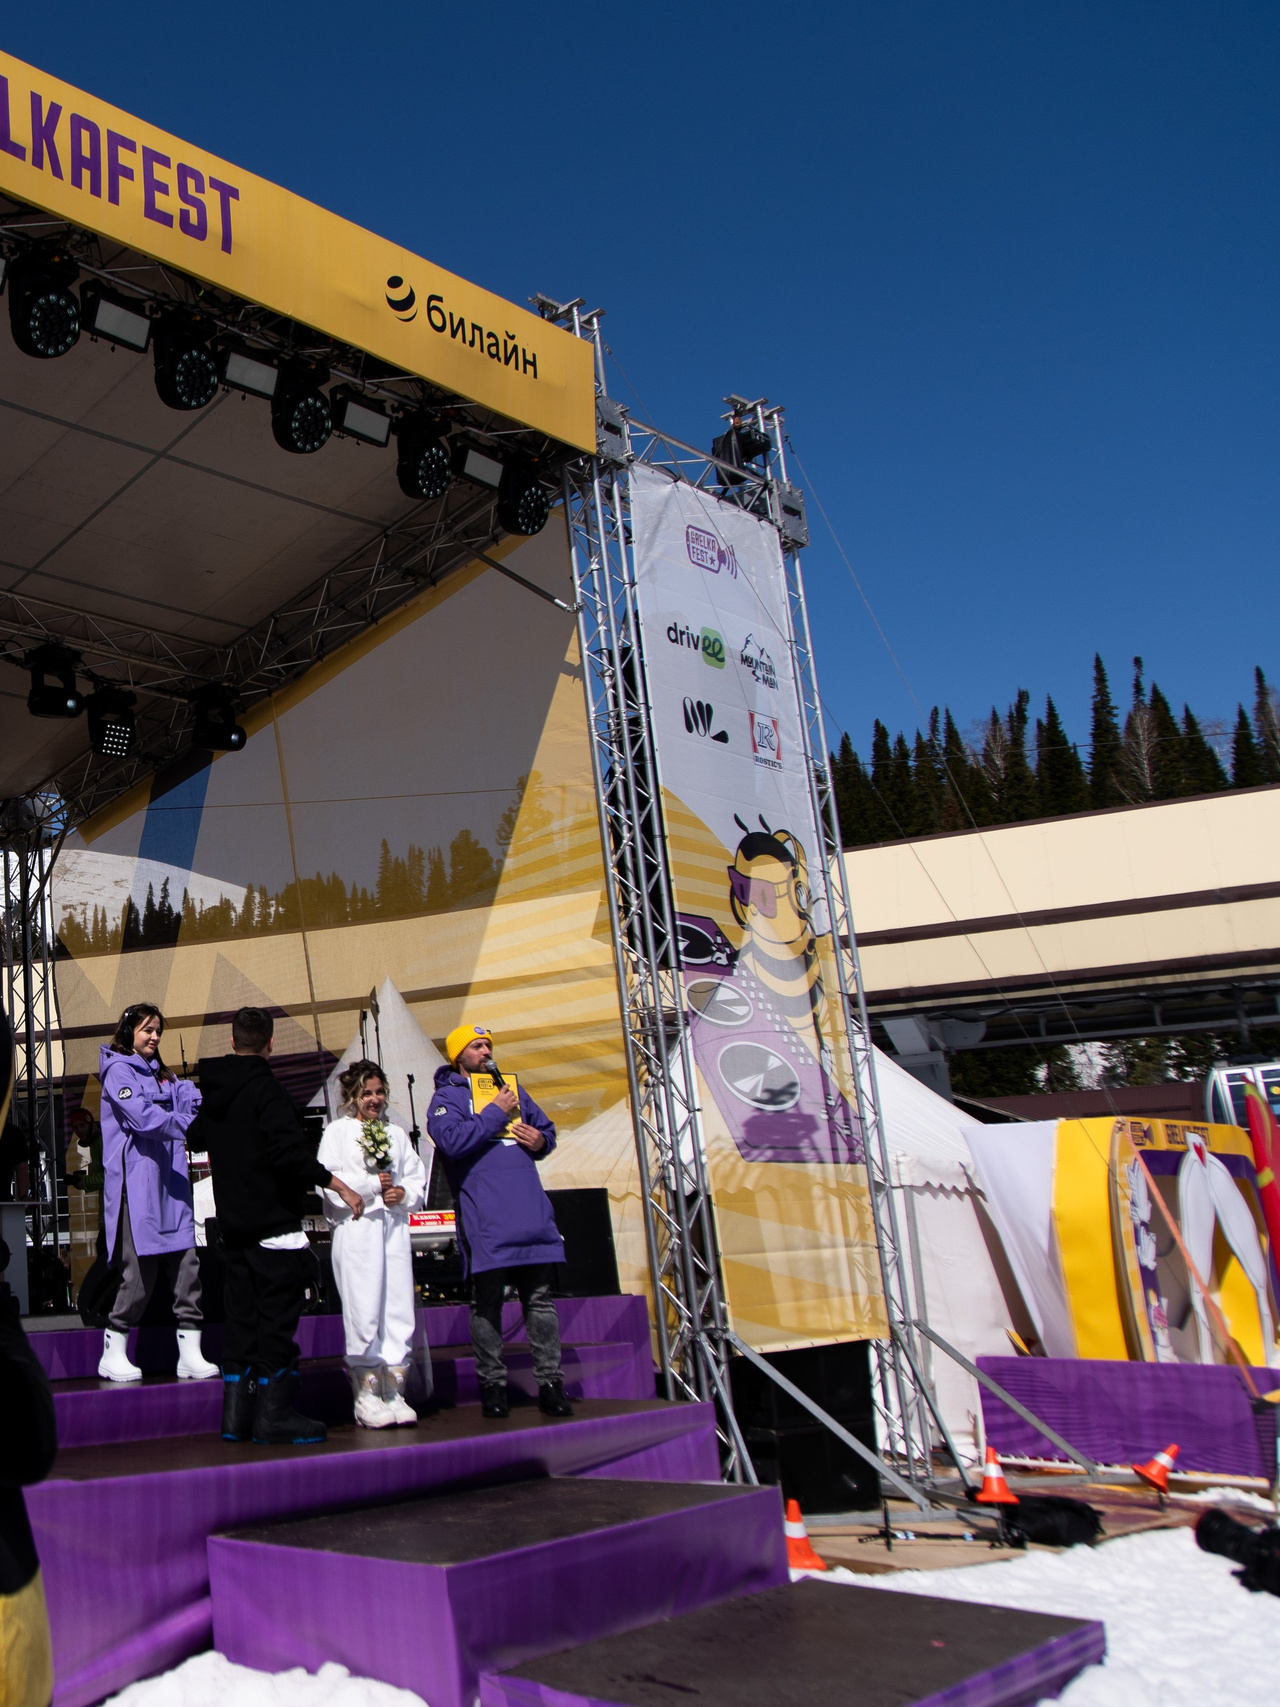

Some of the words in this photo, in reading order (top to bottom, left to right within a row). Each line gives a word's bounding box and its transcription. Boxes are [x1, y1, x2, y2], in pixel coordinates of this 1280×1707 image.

[427, 294, 538, 380] билайн
[691, 531, 716, 552] GRELKA
[692, 545, 708, 564] FEST
[667, 622, 726, 662] drivee
[740, 653, 776, 678] MOUNTAIN
[762, 674, 779, 691] MAN
[754, 755, 783, 770] ROSTIC'S
